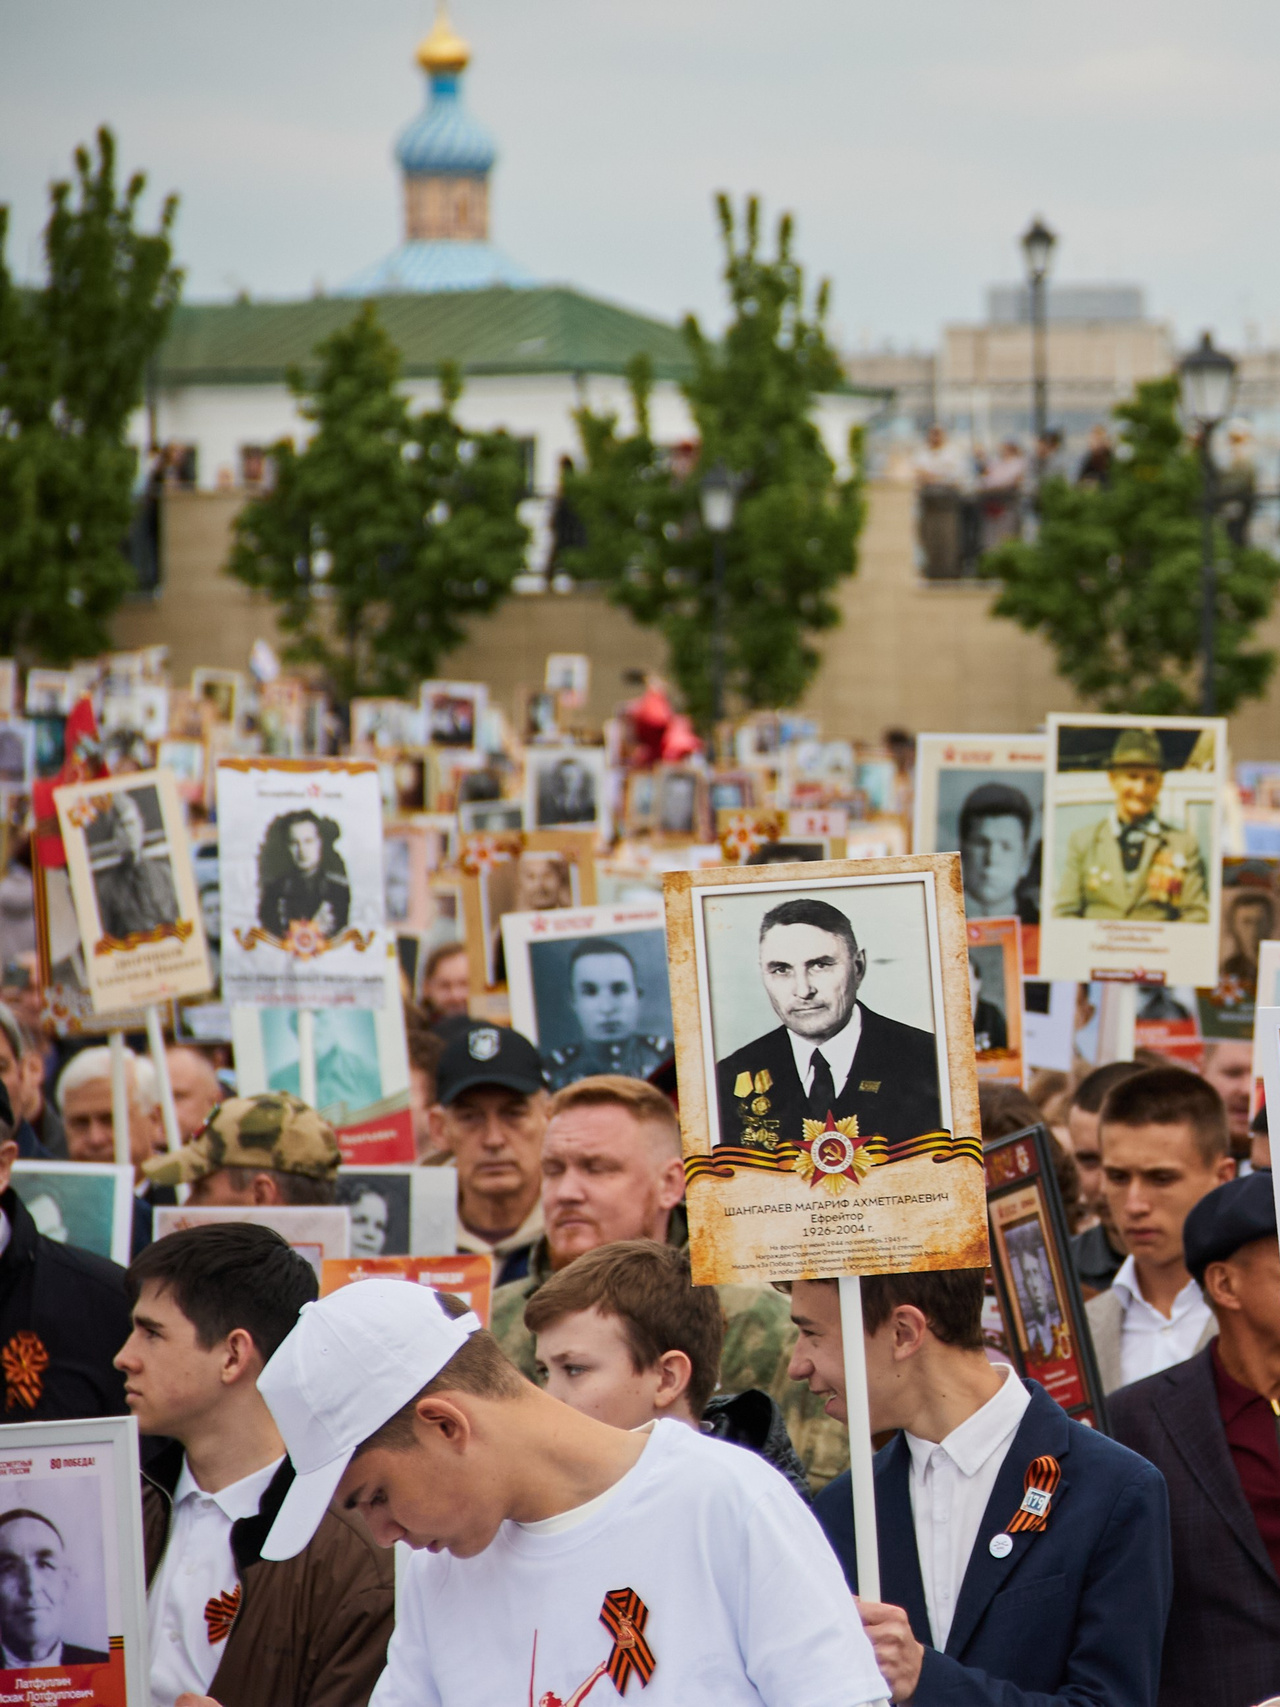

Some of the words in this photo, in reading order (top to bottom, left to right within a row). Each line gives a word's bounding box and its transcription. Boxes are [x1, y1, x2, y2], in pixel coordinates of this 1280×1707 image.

[724, 1204, 792, 1217] ШАНГАРАЕВ
[795, 1199, 850, 1212] МАГАРИФ
[853, 1192, 949, 1207] АХМЕТГАРАЕВИЧ
[811, 1212, 864, 1224] Ефрейтор
[802, 1224, 865, 1237] 1926-2004
[867, 1225, 875, 1233] г.
[50, 1458, 62, 1470] 80
[63, 1457, 95, 1467] ПОБЕДА!
